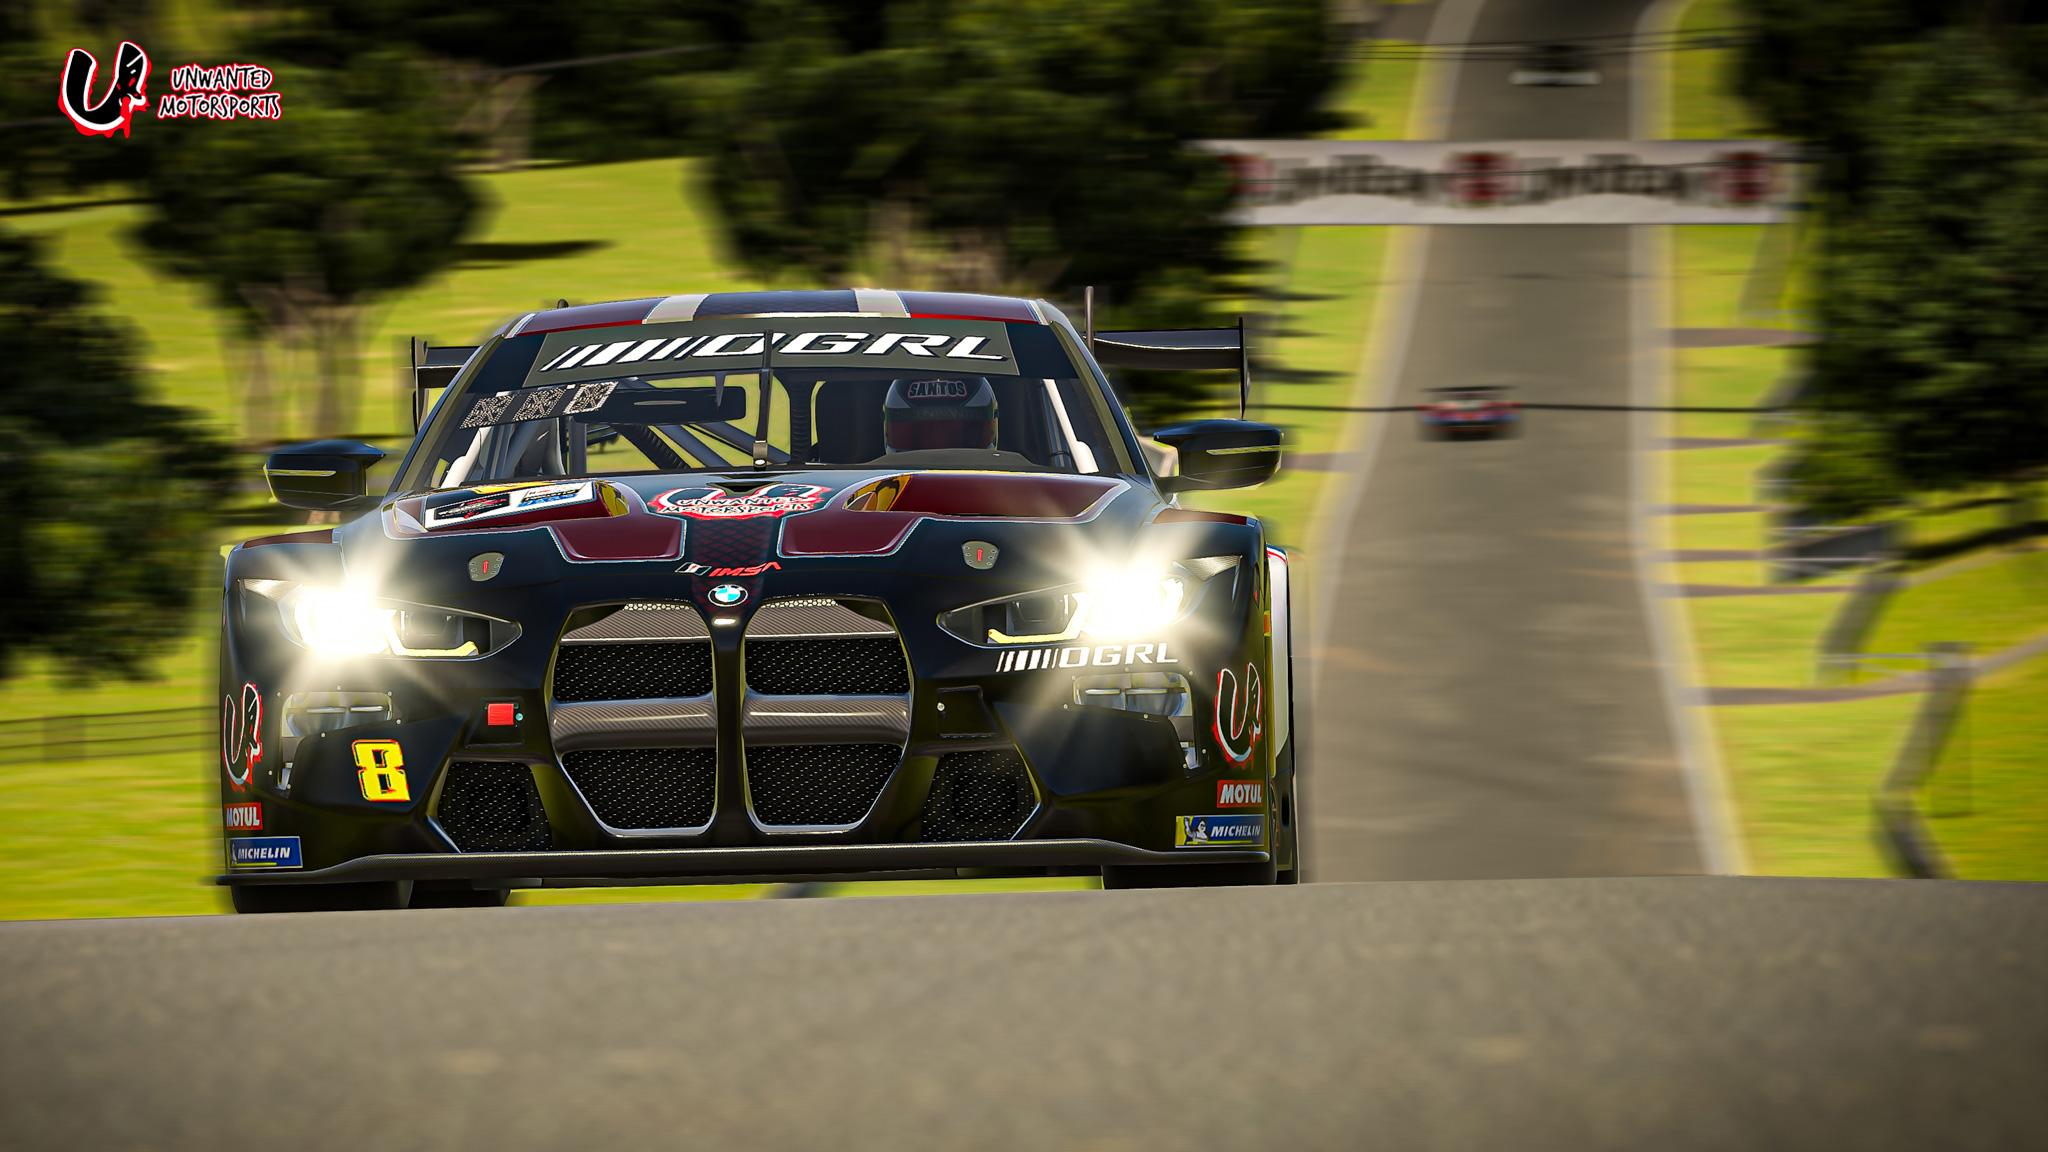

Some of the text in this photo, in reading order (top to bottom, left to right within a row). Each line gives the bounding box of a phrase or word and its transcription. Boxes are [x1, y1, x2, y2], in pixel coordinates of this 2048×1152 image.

[908, 381, 967, 397] SANTOS
[661, 502, 812, 515] MOTORSPORTS
[676, 496, 803, 506] UNWANTED
[708, 561, 782, 577] IMSA
[351, 739, 411, 802] 8
[1219, 783, 1262, 805] MOTUL
[226, 806, 260, 827] MOTUL
[1210, 825, 1261, 838] MICHELIN
[237, 847, 291, 859] MICHELIN
